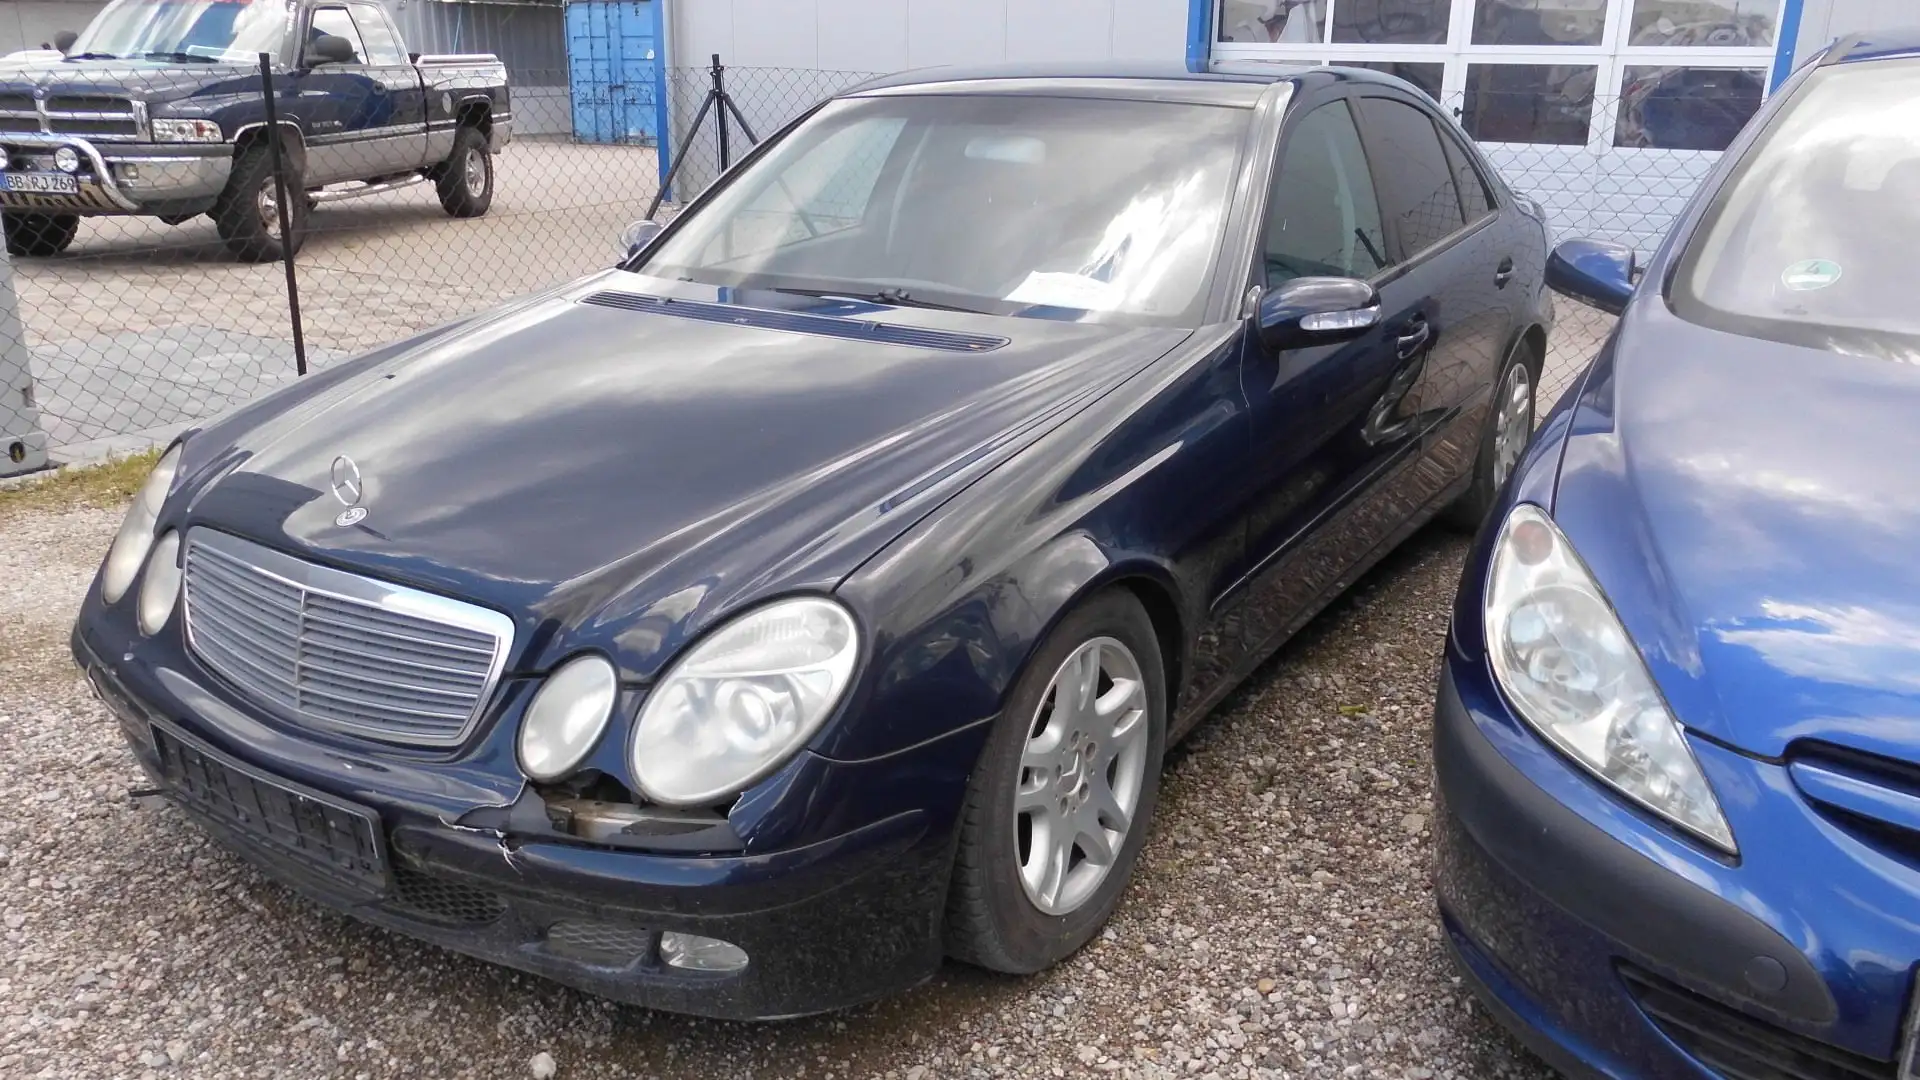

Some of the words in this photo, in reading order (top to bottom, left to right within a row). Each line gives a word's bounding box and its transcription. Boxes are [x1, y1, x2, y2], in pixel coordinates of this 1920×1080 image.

[6, 175, 24, 189] BB
[31, 175, 49, 190] RJ
[1804, 261, 1820, 275] 4
